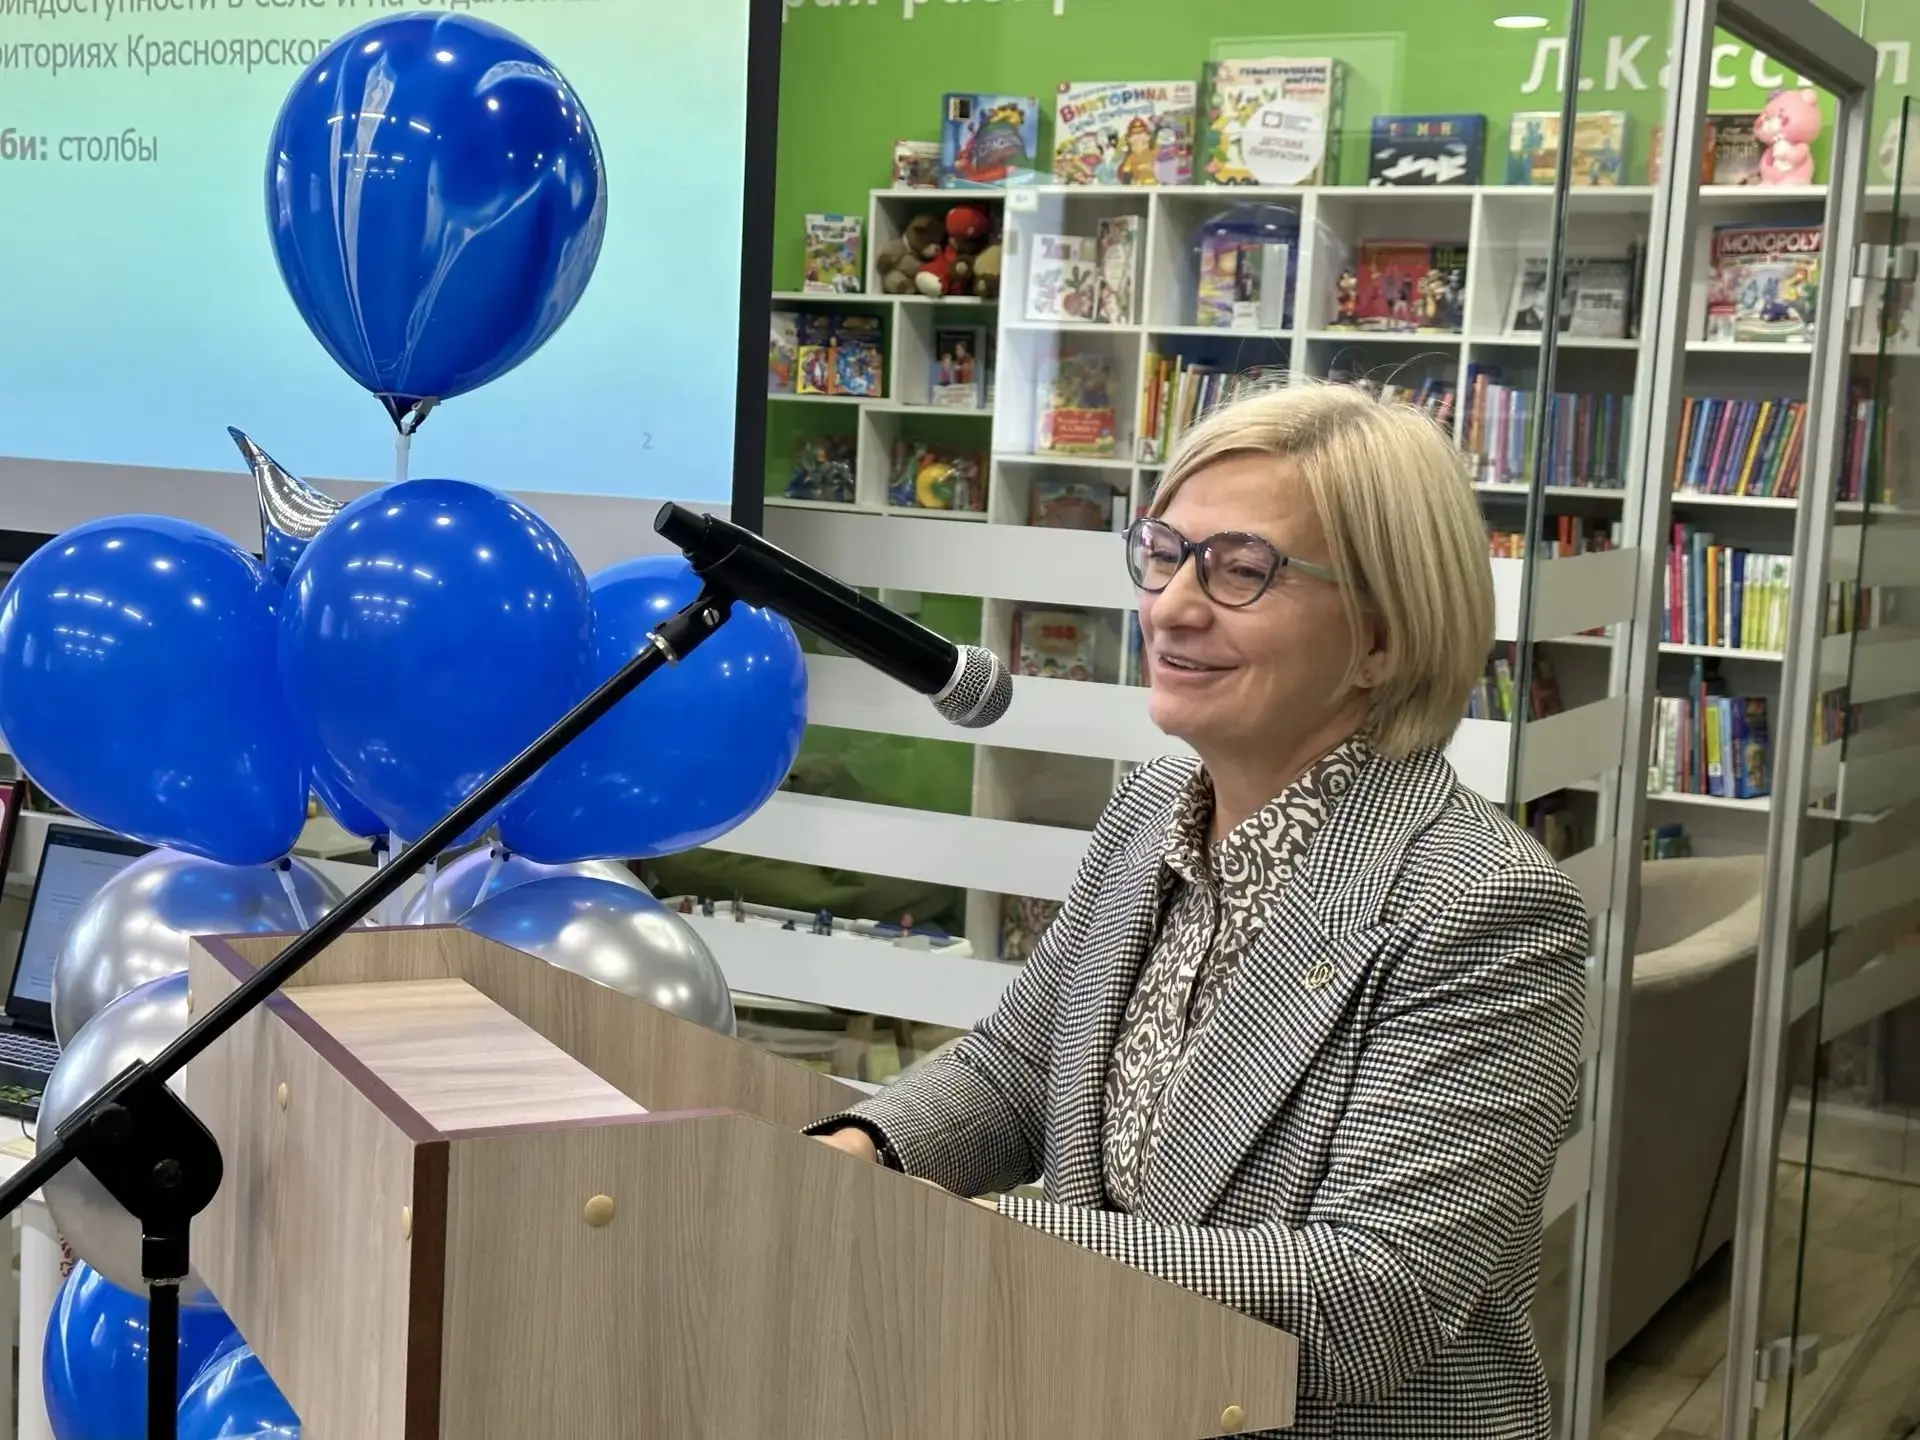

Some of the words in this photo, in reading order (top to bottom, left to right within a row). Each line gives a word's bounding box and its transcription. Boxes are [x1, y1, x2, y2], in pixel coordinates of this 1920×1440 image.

[0, 41, 118, 76] иториях
[58, 128, 158, 162] столбы
[1719, 231, 1820, 252] MONOPOLY
[641, 431, 654, 450] 2
